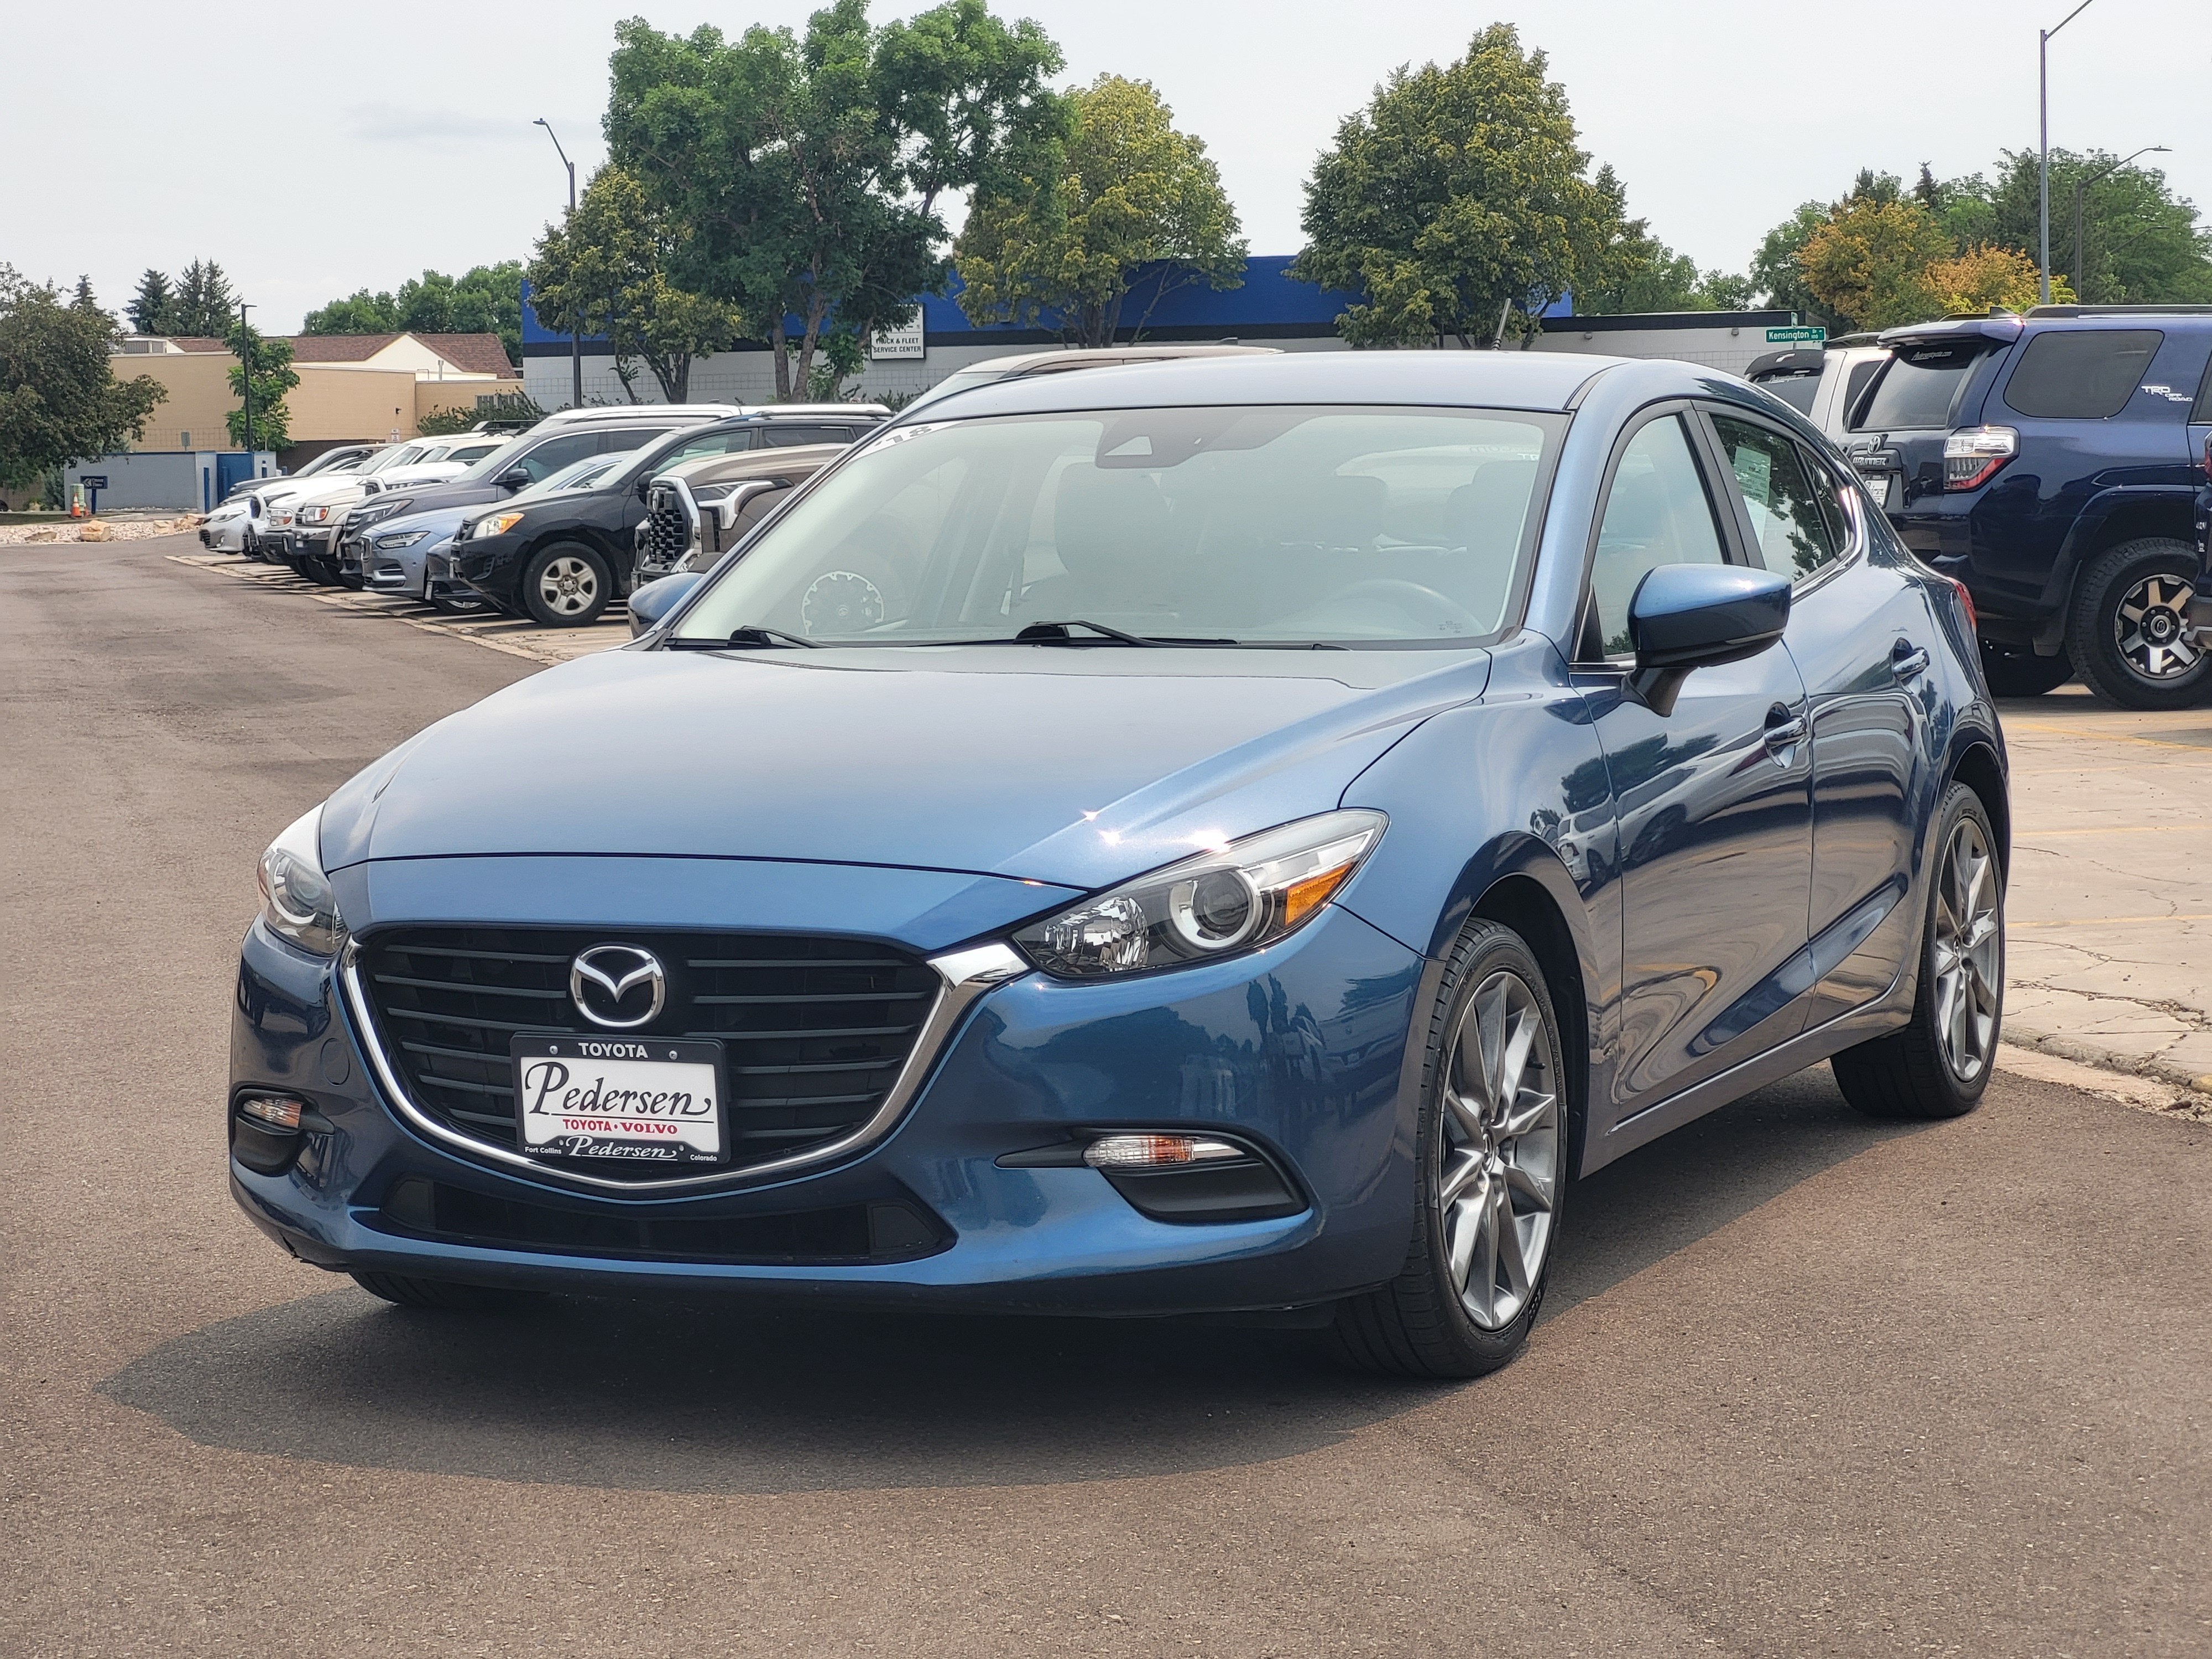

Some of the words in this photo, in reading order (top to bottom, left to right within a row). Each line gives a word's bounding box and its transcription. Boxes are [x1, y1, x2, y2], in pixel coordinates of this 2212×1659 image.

[1768, 331, 1809, 341] Kensington
[2141, 385, 2171, 395] TRD
[578, 1042, 649, 1058] TOYOTA
[525, 1061, 712, 1116] Pedersen
[562, 1119, 612, 1132] TOYOTA
[620, 1122, 677, 1134] VOLVO
[565, 1135, 677, 1158] Pedersen
